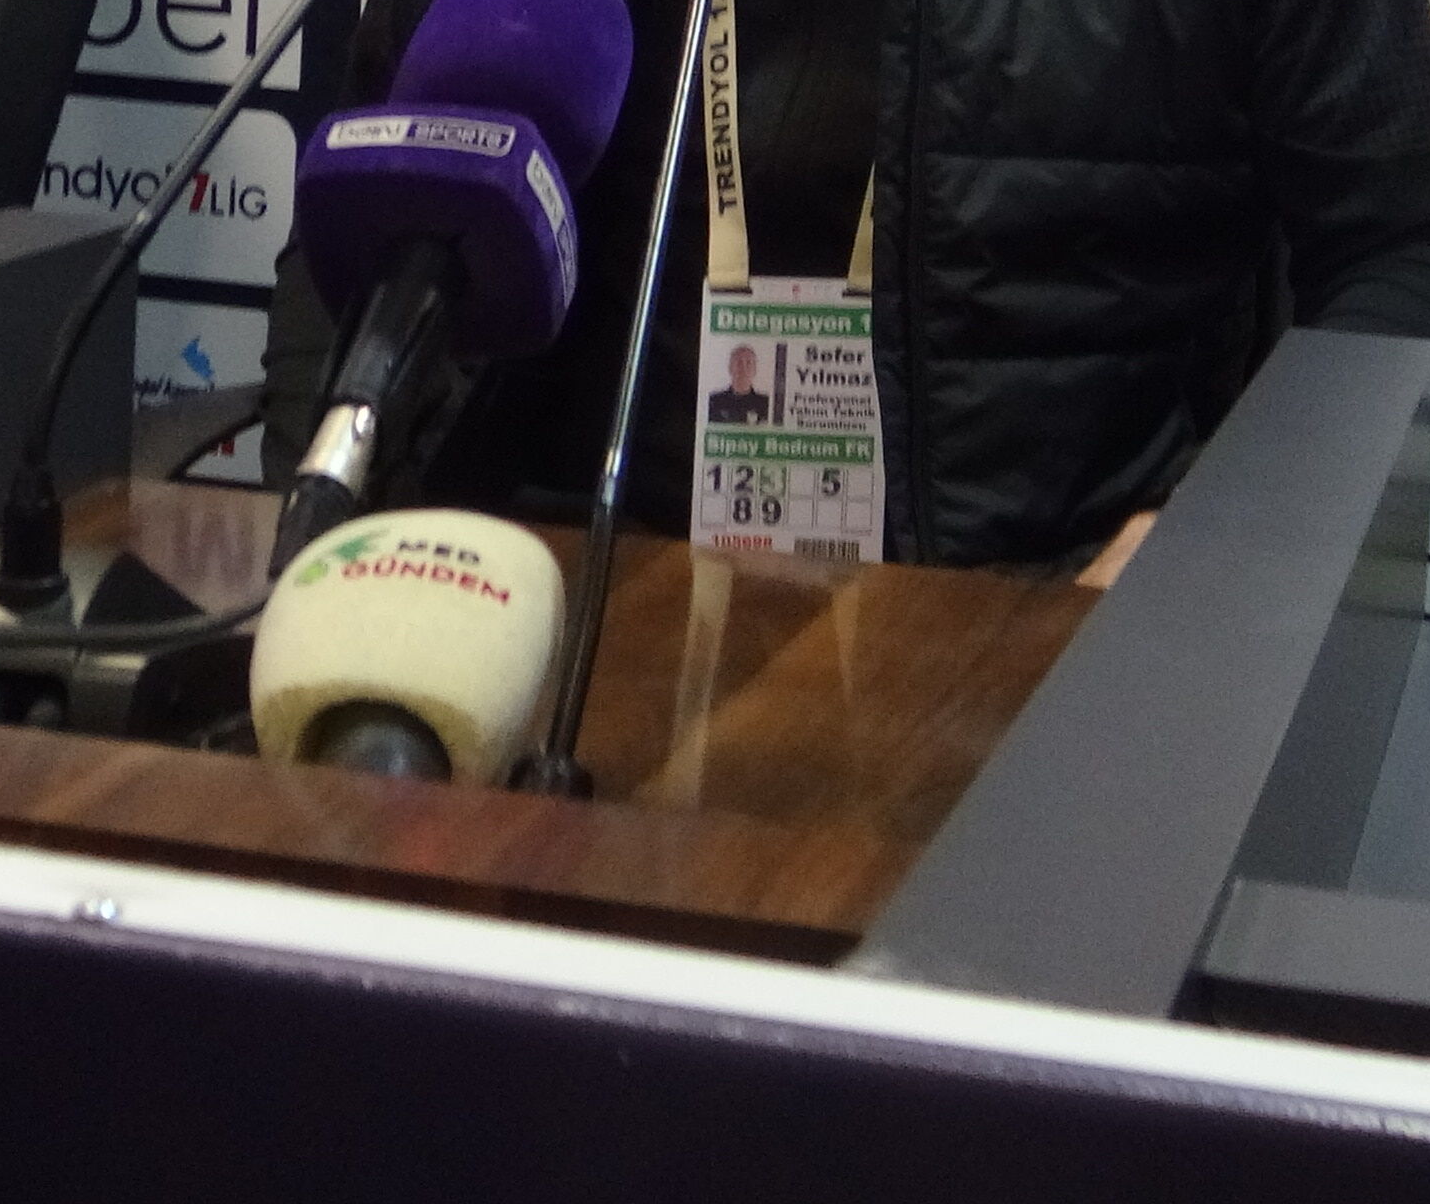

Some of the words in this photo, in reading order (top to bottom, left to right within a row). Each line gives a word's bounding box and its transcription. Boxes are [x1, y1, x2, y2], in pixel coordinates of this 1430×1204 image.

[707, 31, 740, 217] TRENDYOL
[717, 308, 852, 336] Delegasyon
[805, 346, 865, 365] Sefer
[707, 464, 722, 493] 1
[734, 464, 755, 495] 2
[822, 466, 842, 497] 5
[732, 495, 753, 525] 8
[761, 496, 783, 527] 9
